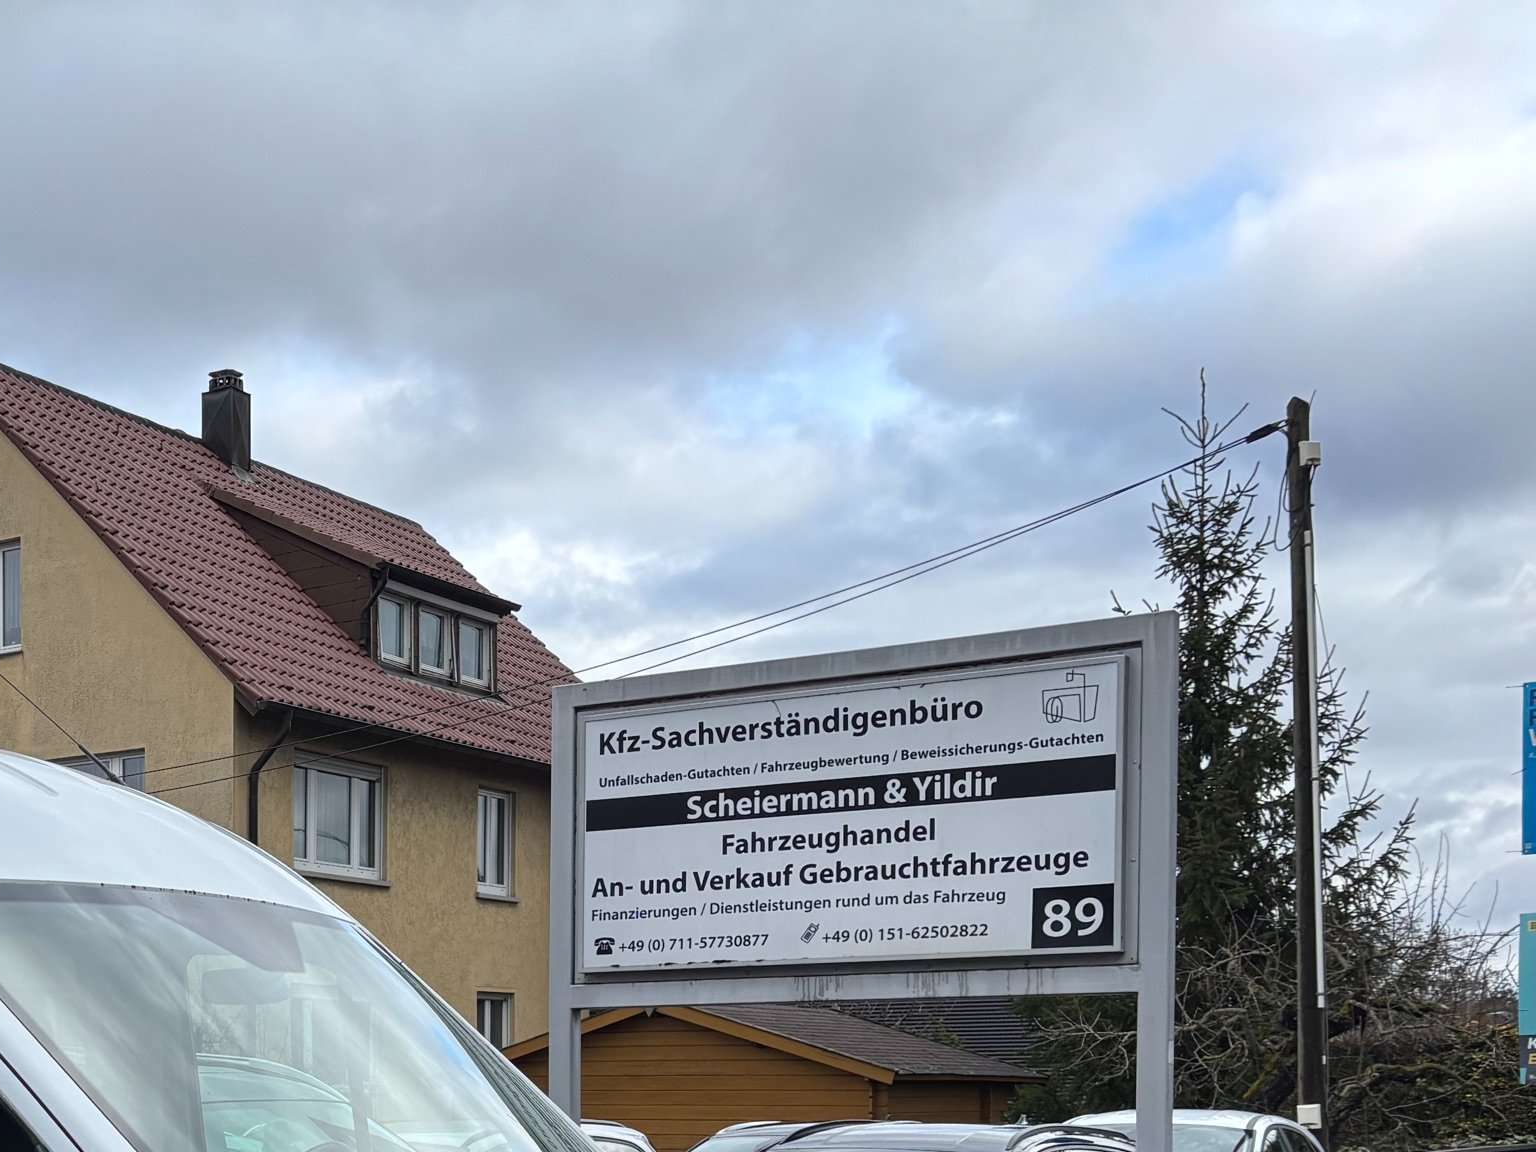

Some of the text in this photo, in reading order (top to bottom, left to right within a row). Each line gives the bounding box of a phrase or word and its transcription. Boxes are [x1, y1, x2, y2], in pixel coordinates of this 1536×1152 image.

[599, 696, 984, 755] Kfz-Sachverständigenbüro
[599, 732, 1104, 788] Unfallschaden-Gutachten / Fahrzeugbewertung / Beweissicherungs-Gutachten
[686, 771, 998, 820] Scheiermann & Yildir
[721, 818, 936, 855] Fahrzeughandel
[592, 850, 1089, 898] An- und Verkauf Gebrauchtfahrzeuge
[591, 889, 1006, 921] Finanzierungen / Dienstleistungen rund um das Fahrzeug
[1042, 897, 1104, 938] 89
[619, 934, 769, 952] +49 (0) 711-57730877
[822, 924, 989, 943] +49 (0) 151-62502822
